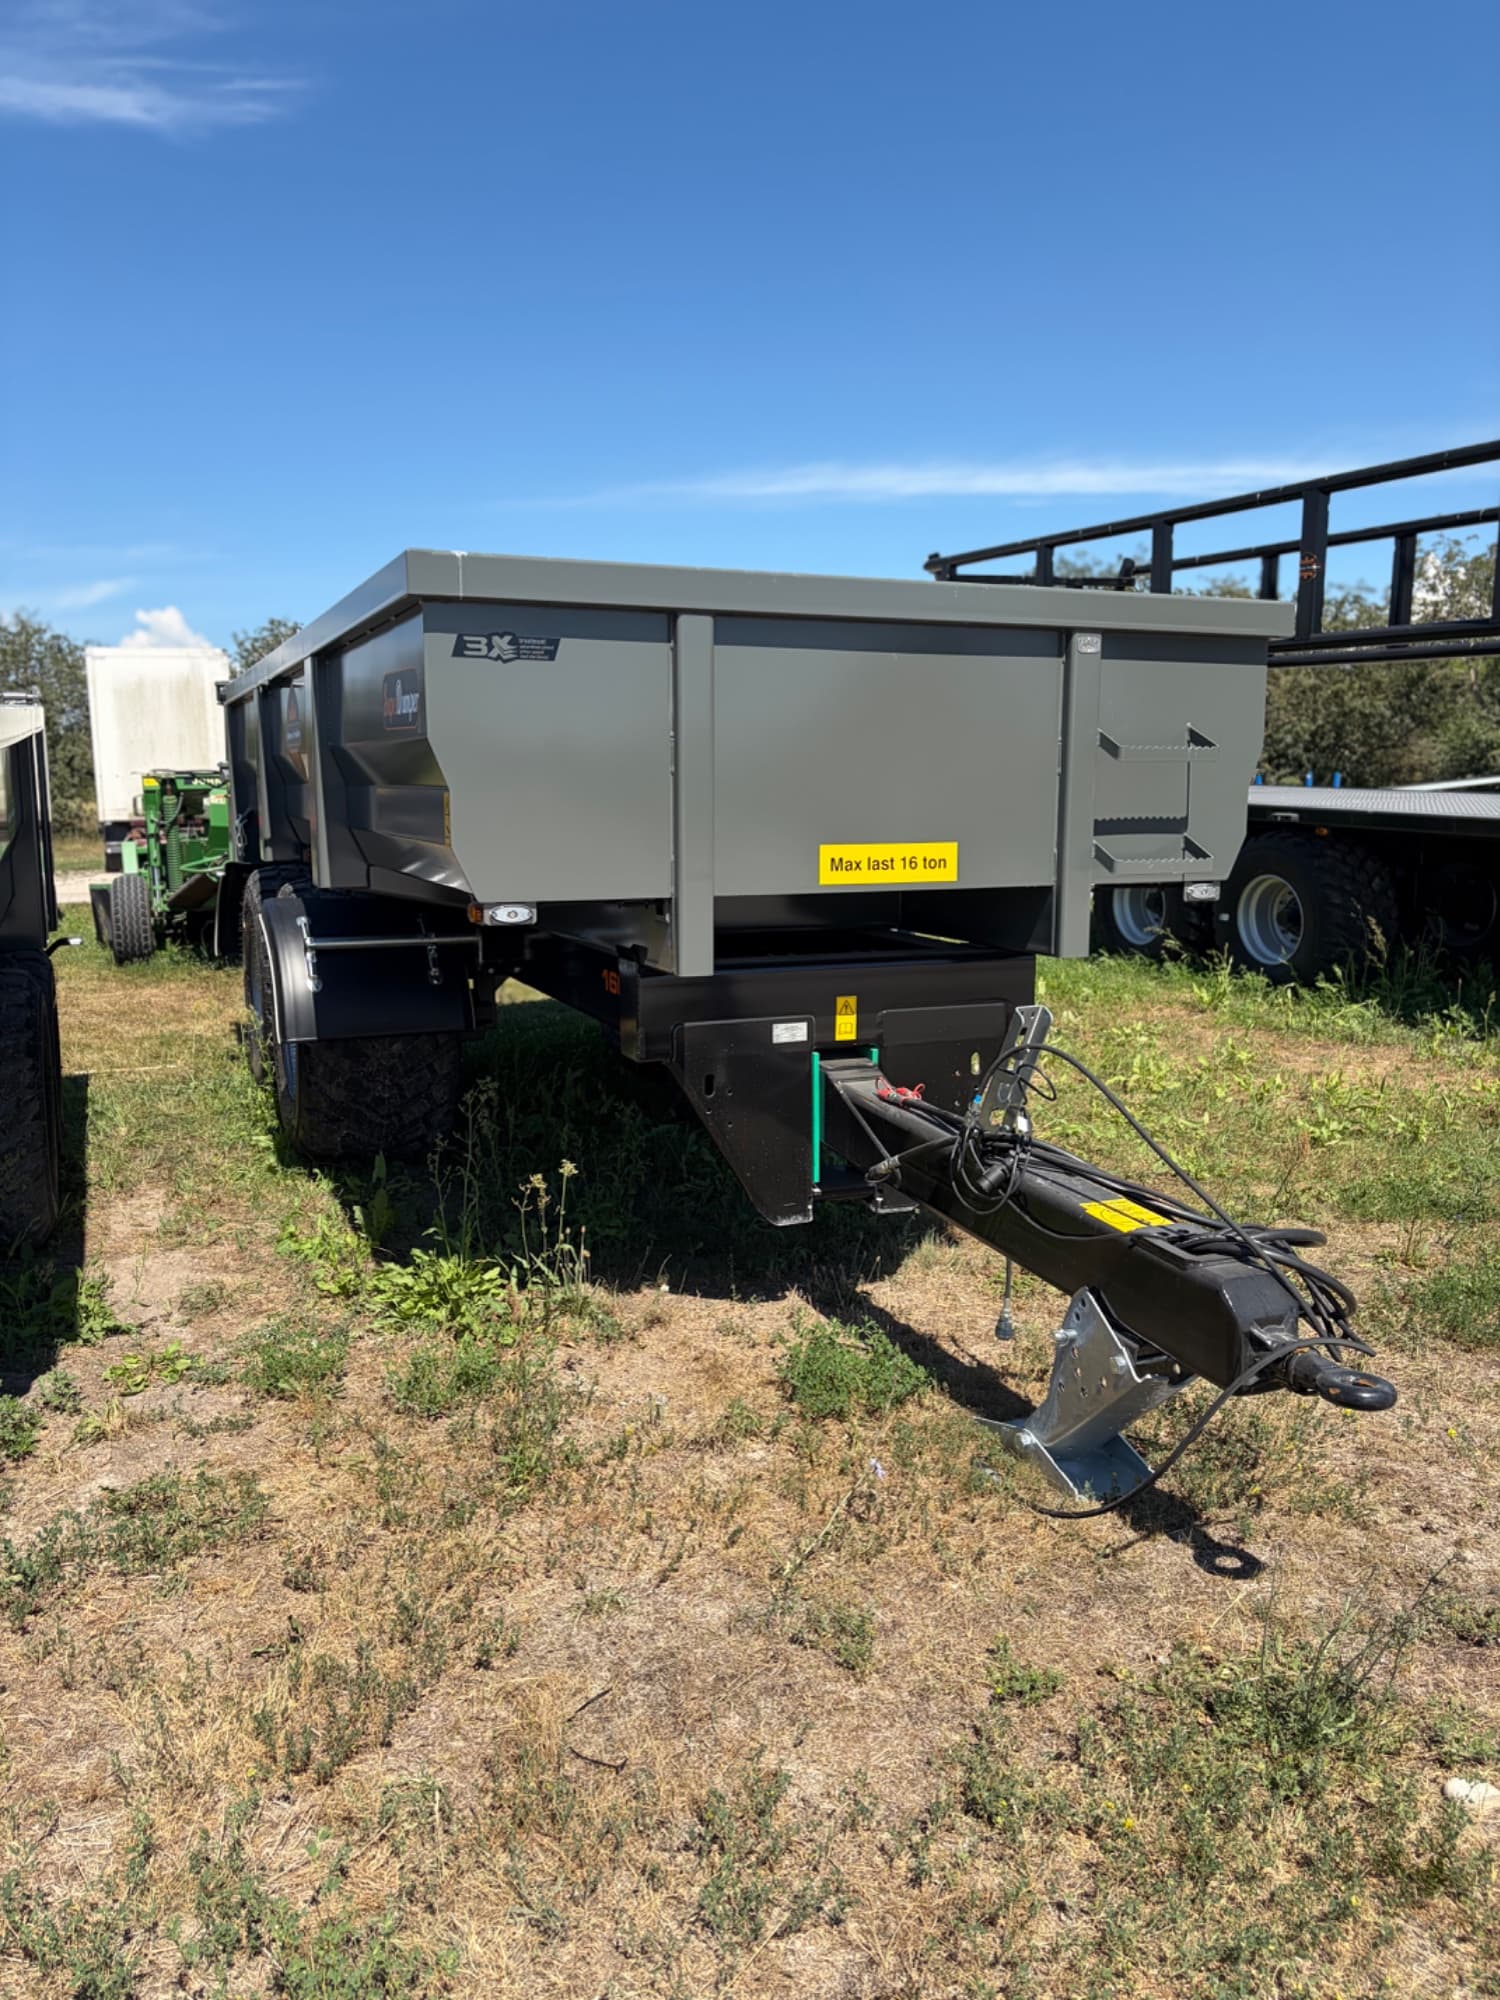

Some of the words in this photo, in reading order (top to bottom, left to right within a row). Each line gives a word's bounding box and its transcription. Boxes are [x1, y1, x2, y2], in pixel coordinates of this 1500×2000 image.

[463, 635, 516, 660] 3X
[830, 857, 862, 871] Max
[867, 857, 895, 870] last
[901, 856, 918, 870] 16
[923, 856, 947, 869] ton
